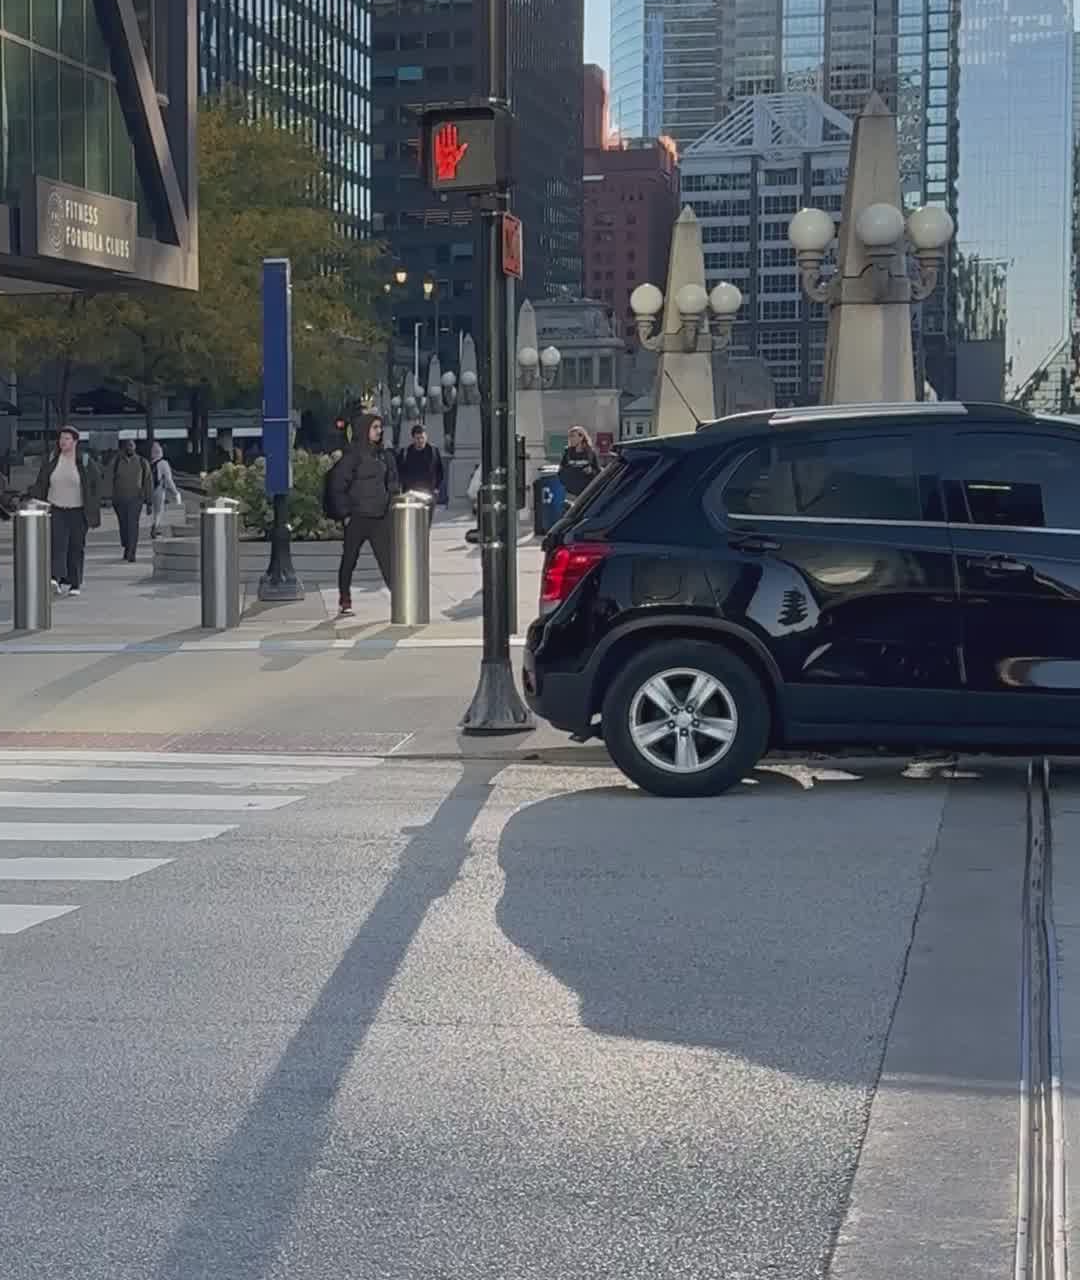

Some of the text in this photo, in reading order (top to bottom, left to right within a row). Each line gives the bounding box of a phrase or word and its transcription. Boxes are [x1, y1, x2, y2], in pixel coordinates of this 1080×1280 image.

[65, 200, 99, 225] FITNESS
[66, 226, 129, 259] FORMULA CLUBS
